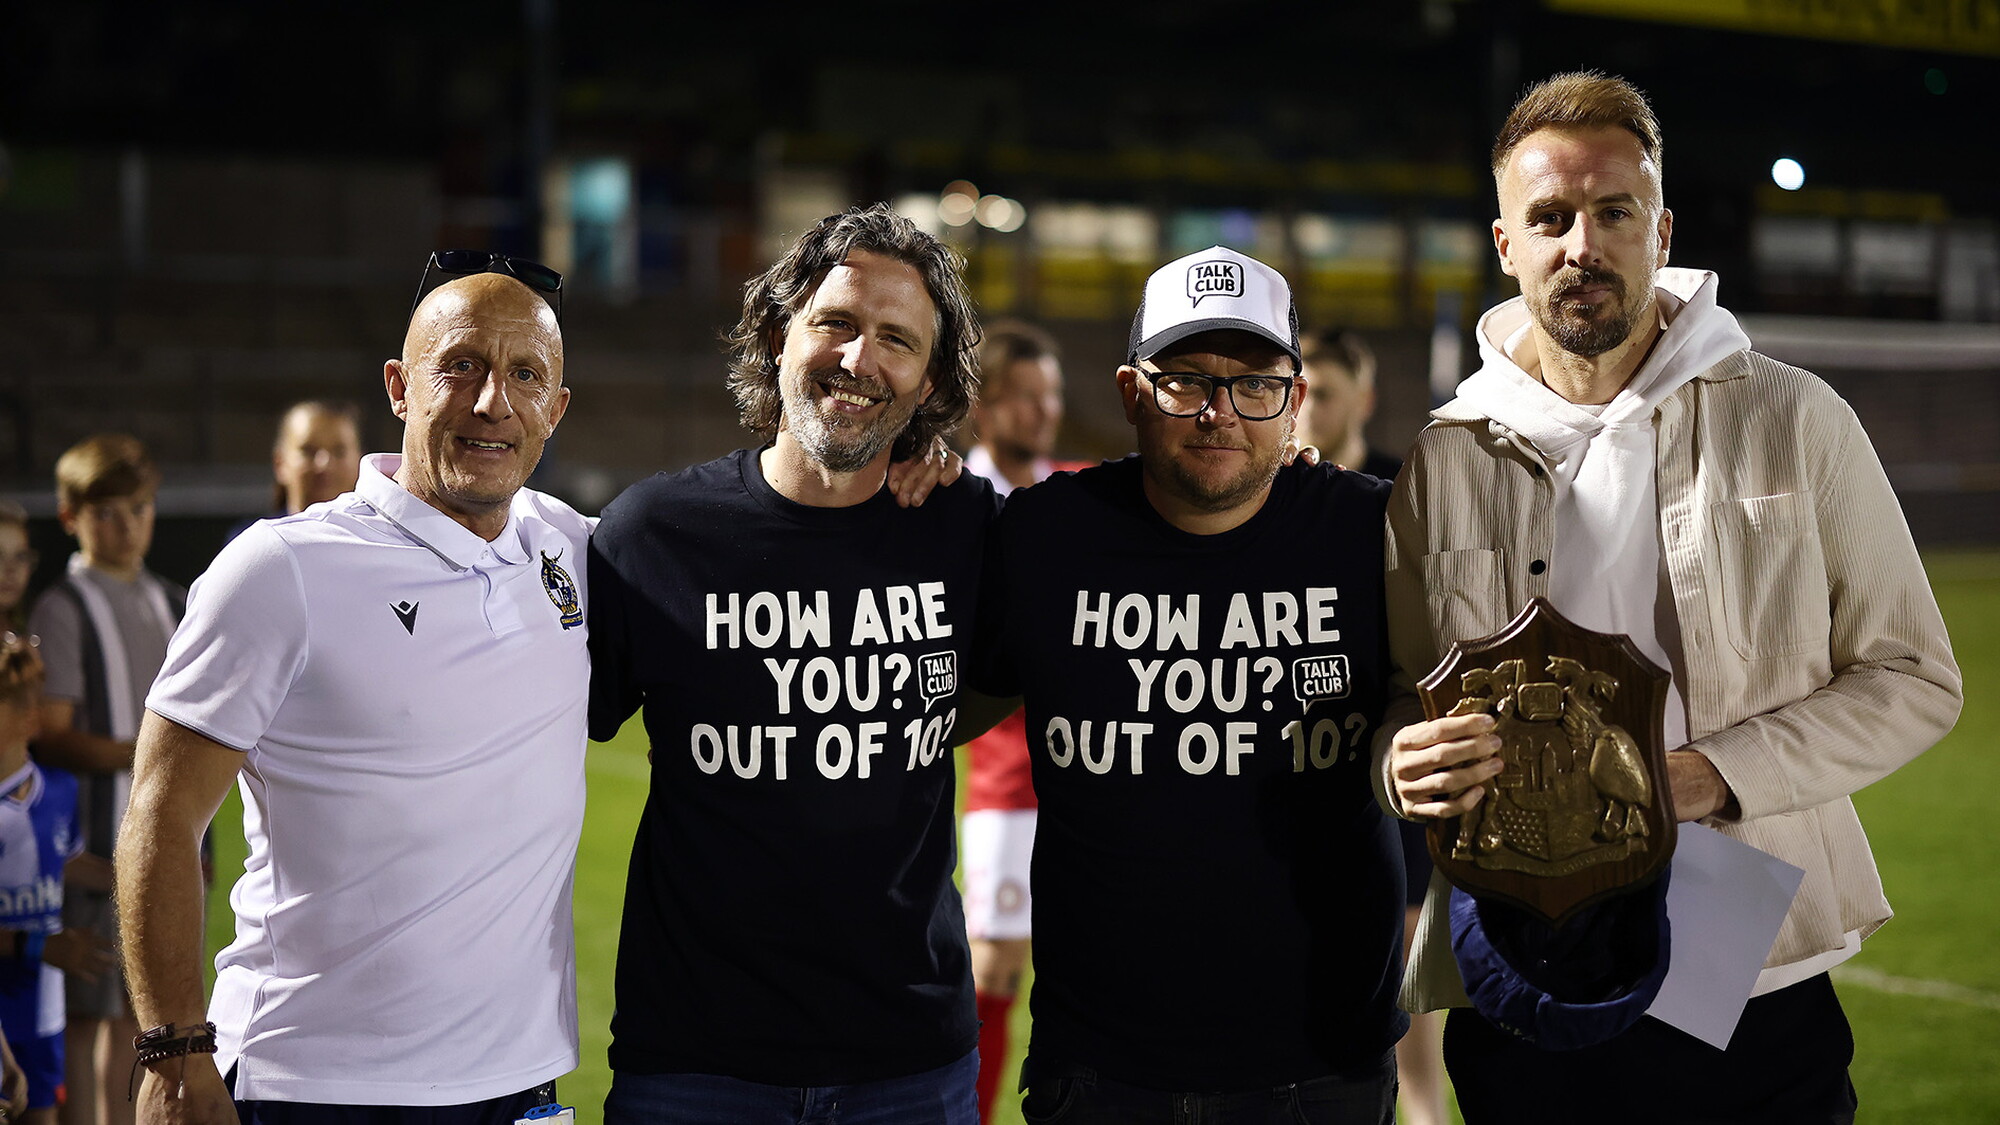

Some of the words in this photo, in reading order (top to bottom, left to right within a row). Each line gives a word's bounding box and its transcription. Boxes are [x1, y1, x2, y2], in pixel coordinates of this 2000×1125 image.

[1194, 278, 1236, 293] CLUB
[1195, 264, 1235, 279] TALK
[706, 591, 831, 650] HOW
[850, 581, 953, 646] ARE
[1072, 590, 1200, 651] HOW
[1219, 587, 1341, 650] ARE
[763, 652, 912, 715] YOU?
[924, 656, 953, 677] TALK
[927, 673, 954, 694] CLUB
[1127, 656, 1285, 714] YOU?
[1301, 660, 1341, 679] TALK
[1303, 676, 1343, 696] CLUB
[691, 722, 797, 781] OUT
[815, 721, 888, 780] OF
[903, 707, 957, 772] 10?
[1045, 716, 1154, 776] OUT
[1178, 721, 1258, 776] OF
[1281, 712, 1368, 773] 10?
